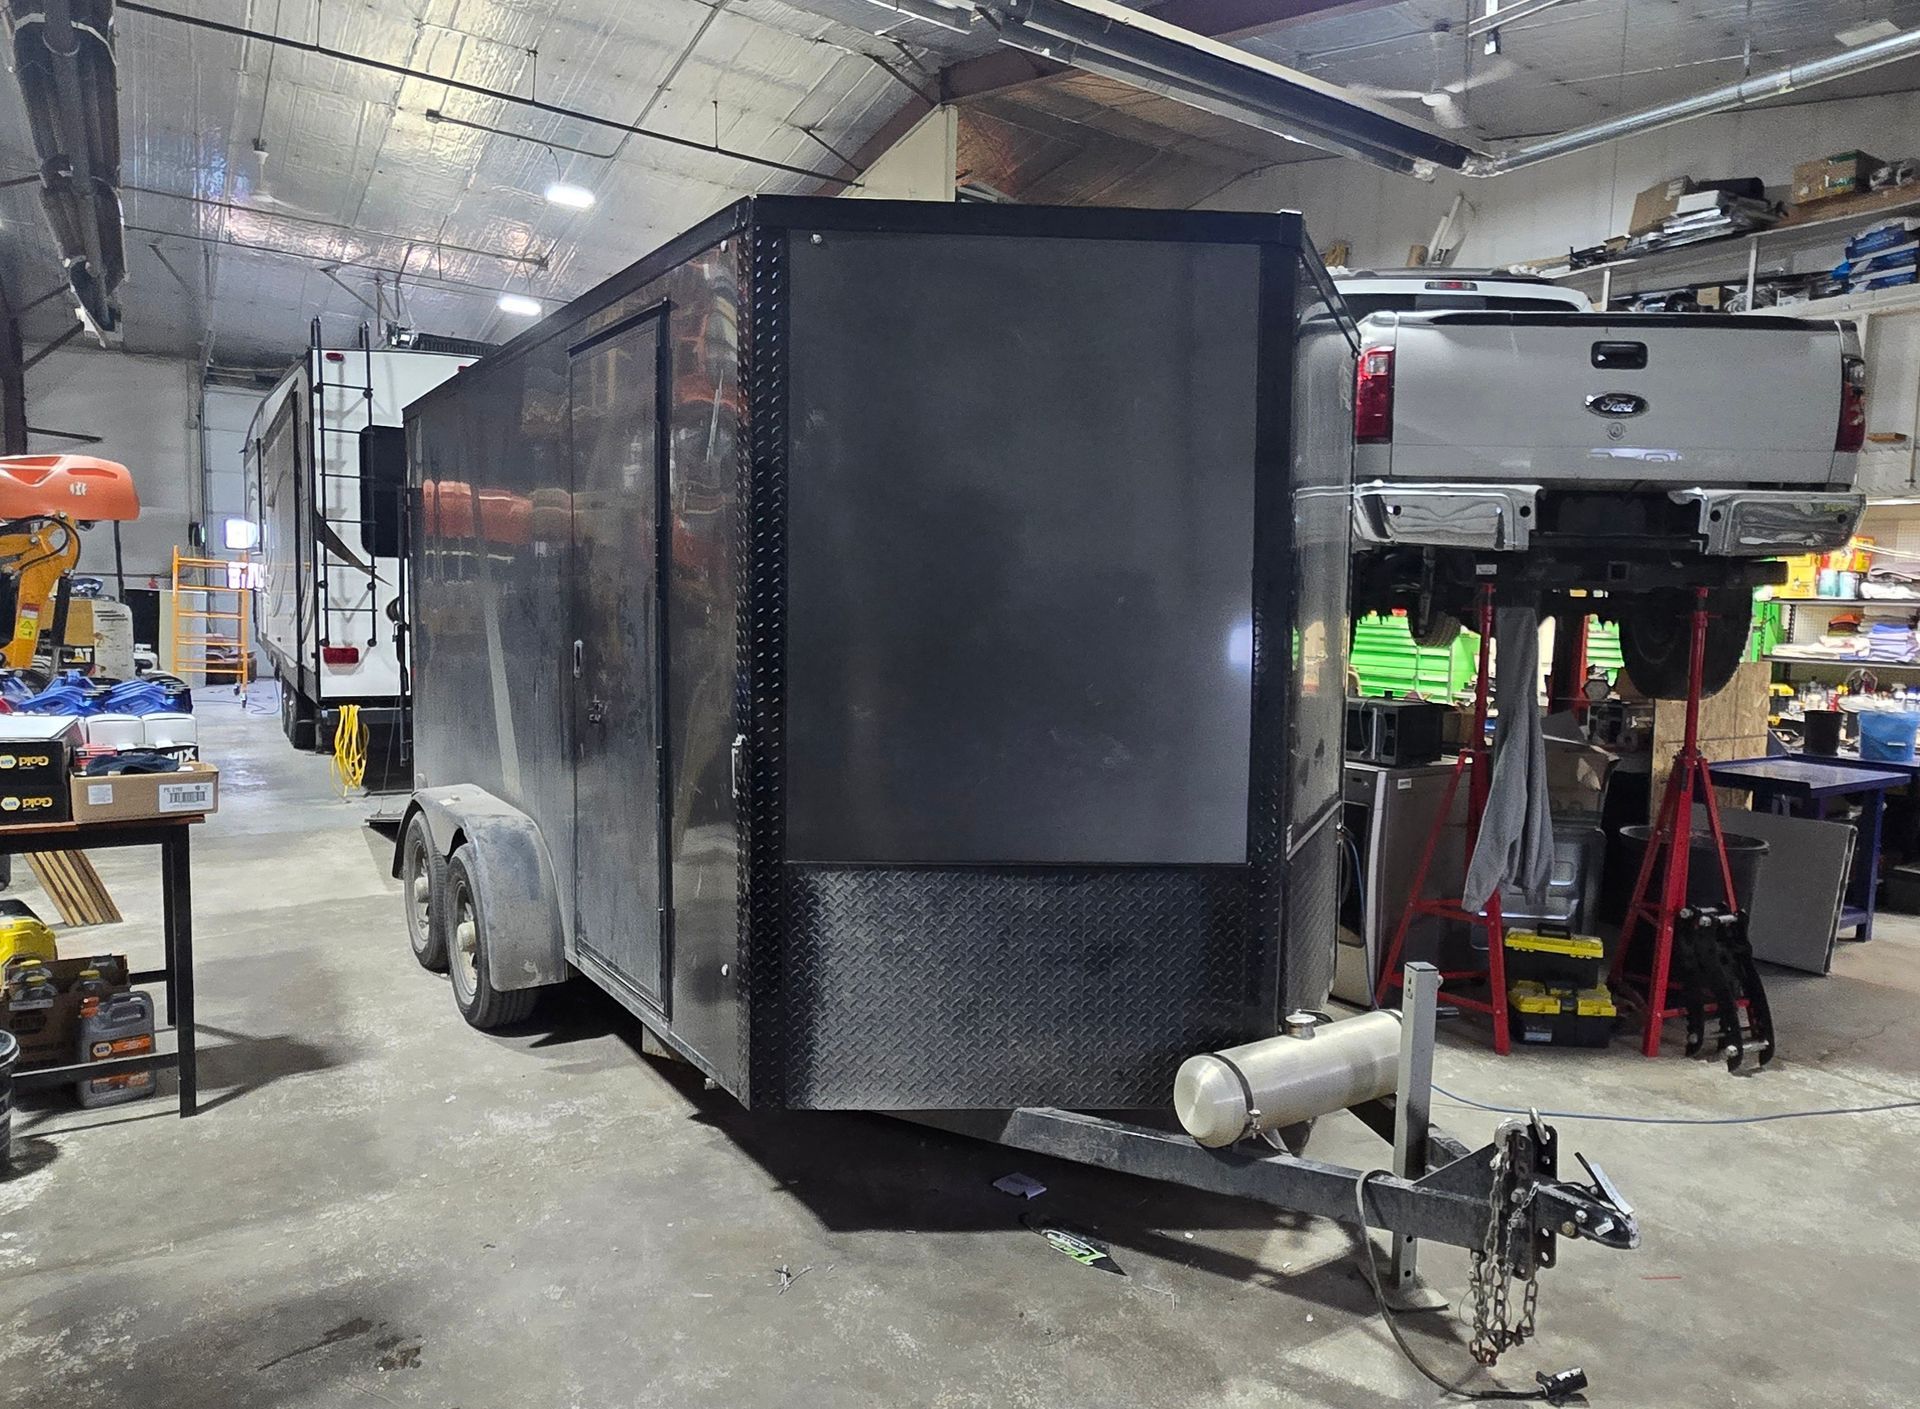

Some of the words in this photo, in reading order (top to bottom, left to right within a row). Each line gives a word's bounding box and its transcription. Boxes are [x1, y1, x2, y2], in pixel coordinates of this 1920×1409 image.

[1601, 398, 1636, 413] Ford
[18, 755, 49, 767] Gold
[22, 797, 53, 808] Gold
